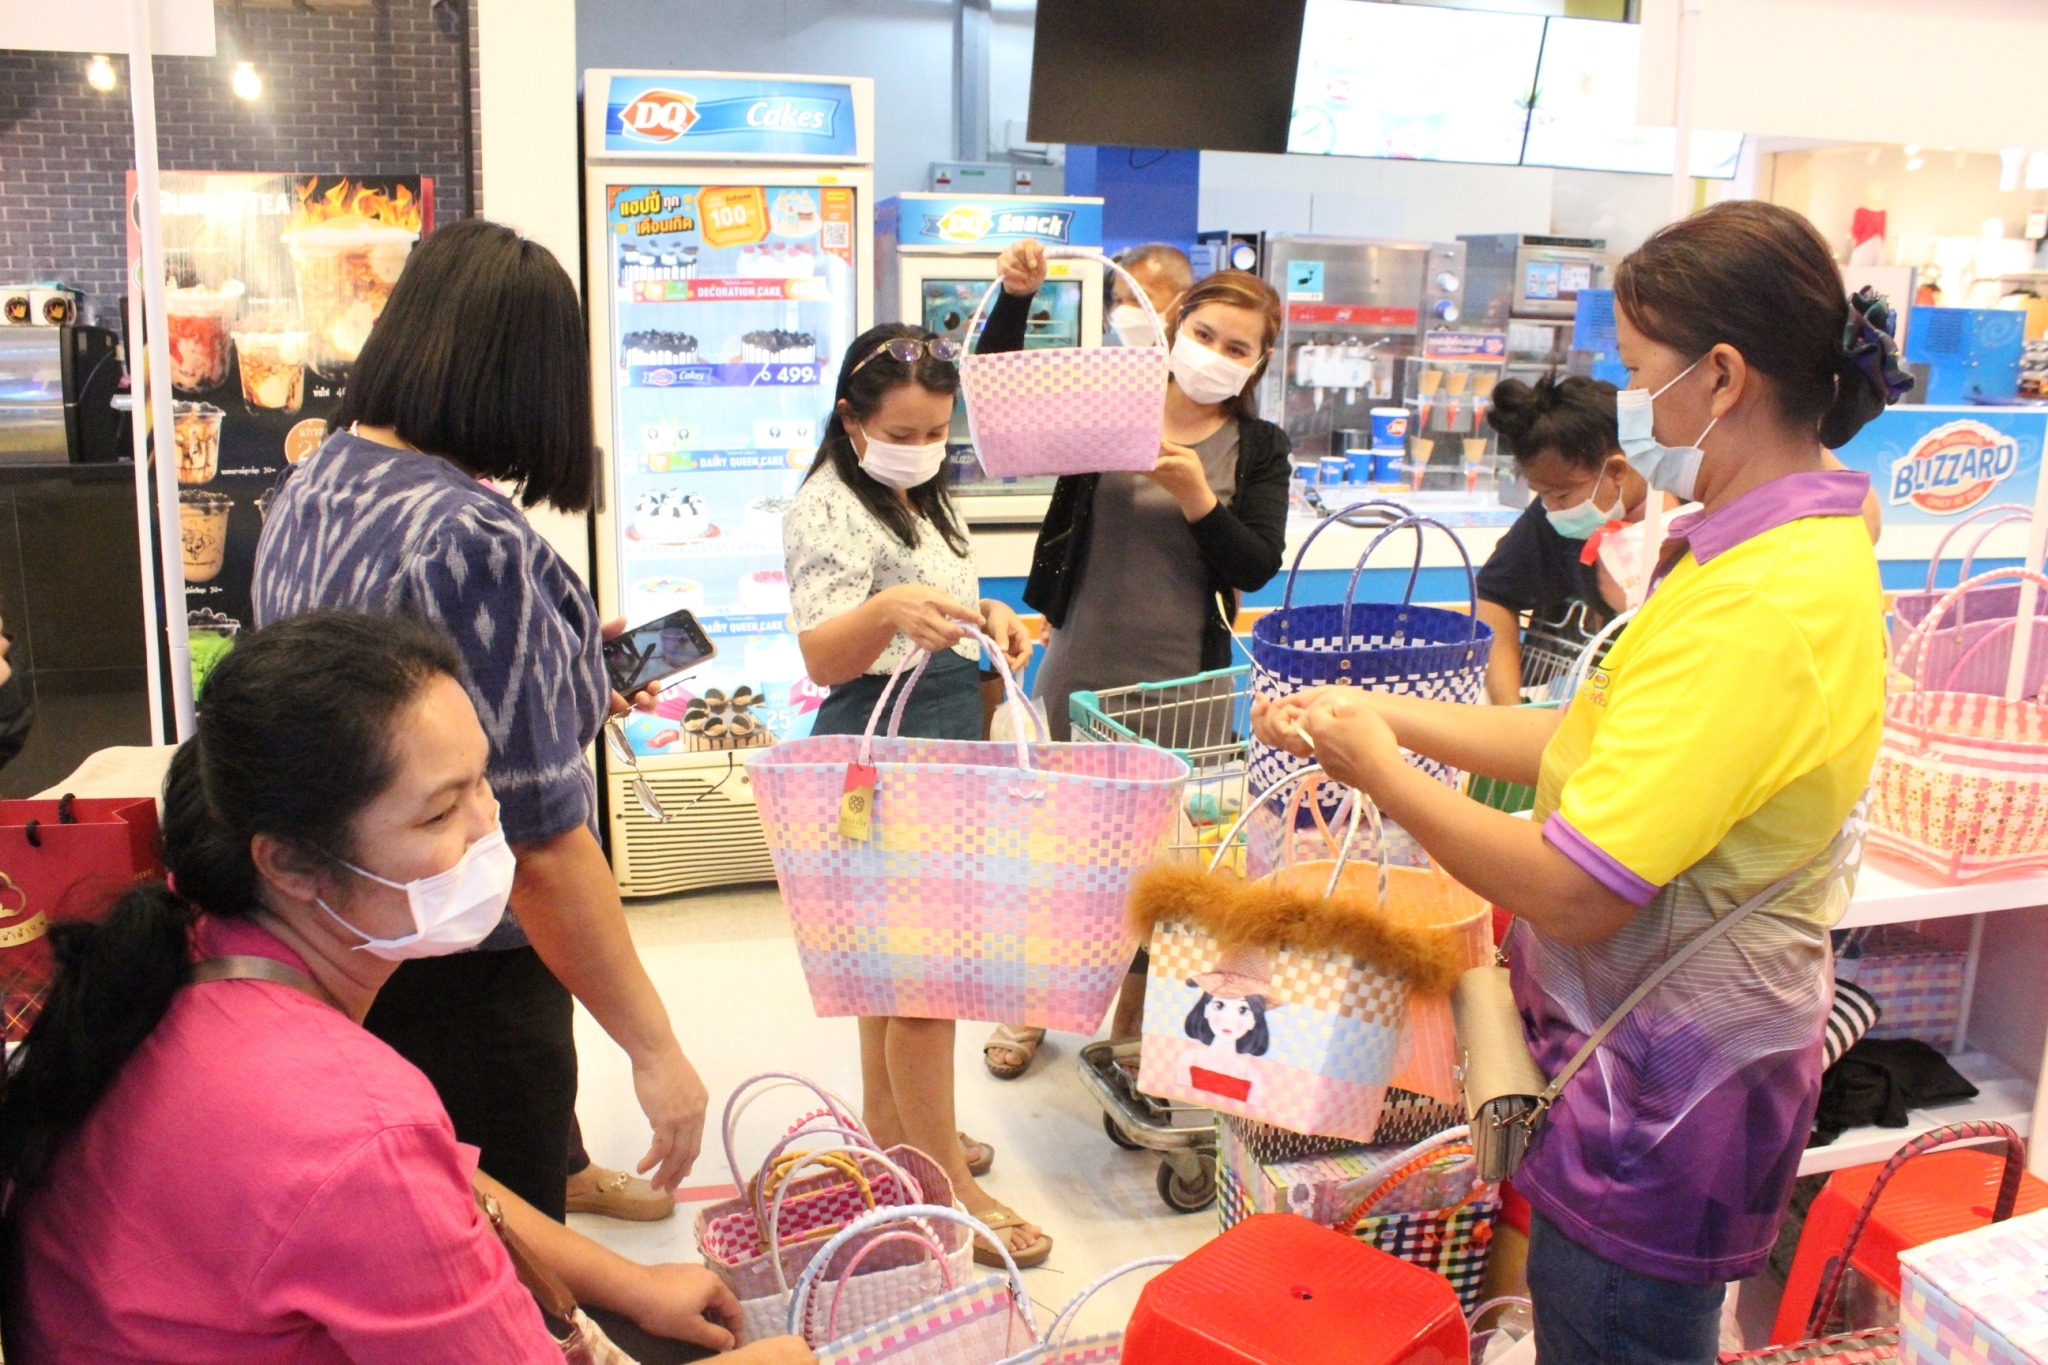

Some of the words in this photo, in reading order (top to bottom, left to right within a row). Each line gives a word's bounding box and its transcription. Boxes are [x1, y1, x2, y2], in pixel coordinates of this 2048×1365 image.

[633, 101, 688, 133] DQ
[746, 102, 825, 129] Cakes
[710, 205, 747, 228] 100
[997, 213, 1063, 237] Snack
[697, 286, 756, 298] DECORATION
[757, 286, 781, 297] CAKE
[679, 370, 705, 381] Cakes
[700, 457, 727, 468] DAIRY
[729, 456, 759, 468] QUEEN
[760, 455, 784, 466] CAKE
[1893, 443, 2014, 500] BLIZZARD
[702, 623, 728, 634] DAIRY
[729, 621, 759, 633] QUEEN
[760, 620, 783, 632] CAKE
